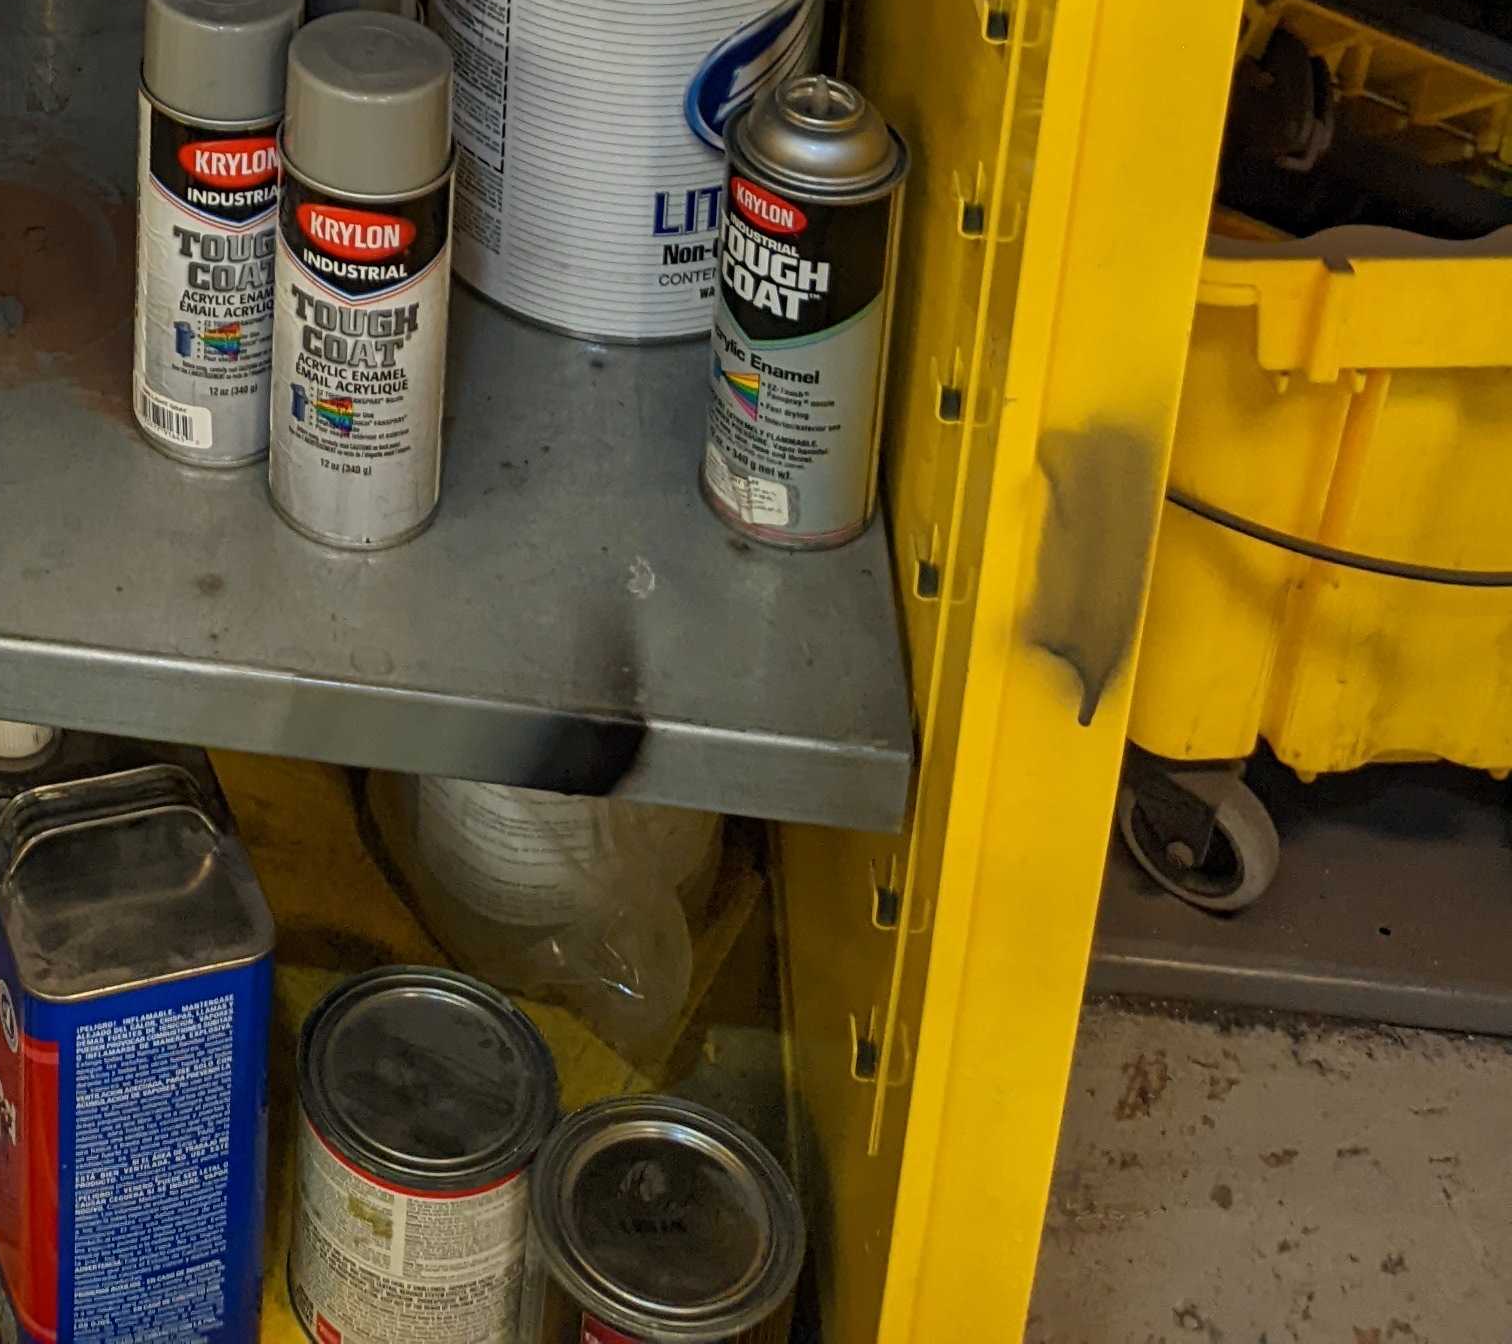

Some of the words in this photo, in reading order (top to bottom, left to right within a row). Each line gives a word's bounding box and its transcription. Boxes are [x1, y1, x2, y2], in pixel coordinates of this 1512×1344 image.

[188, 185, 280, 207] INDUSTRIA
[735, 184, 795, 228] KRYLON
[173, 226, 276, 264] TOUG
[310, 213, 400, 248] KRYLON
[730, 212, 800, 257] INDUSTRIAL
[303, 248, 408, 280] INDUSTRIAL
[720, 213, 829, 292] TOUGH
[183, 289, 239, 306] ACRYLIC
[721, 253, 811, 321] COAT
[291, 284, 420, 338] TOUGH
[302, 327, 405, 369] COAT
[297, 353, 349, 381] ACRYLIC
[352, 365, 407, 381] ENAMEL
[750, 351, 820, 386] Enamel
[334, 378, 409, 395] ACRYLIQUE
[320, 458, 330, 469] 12
